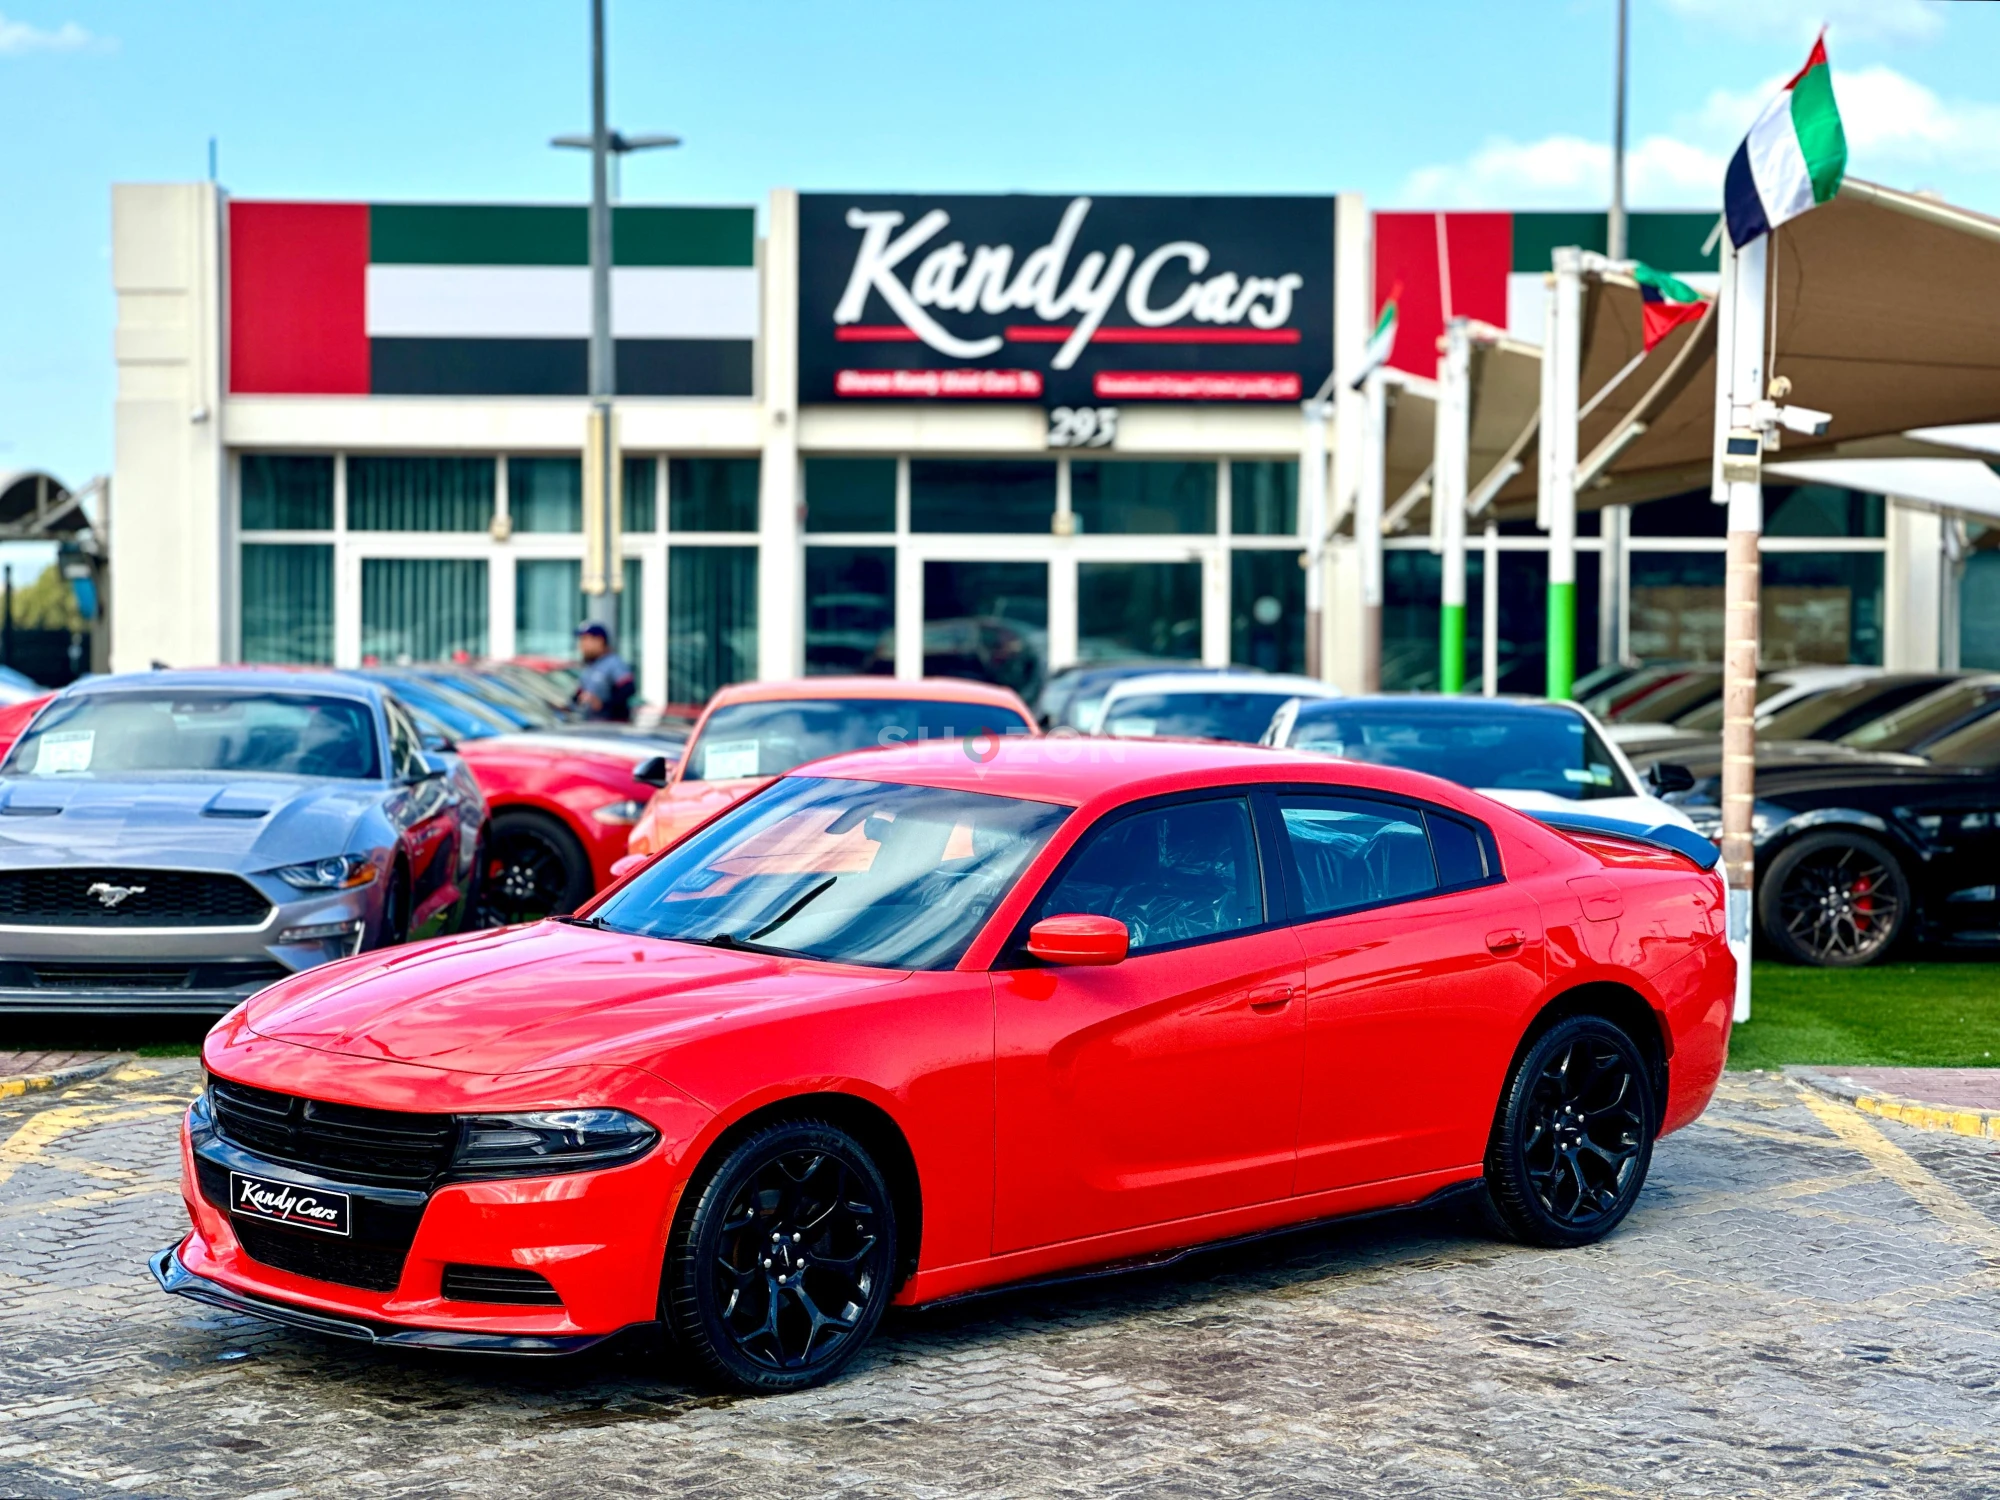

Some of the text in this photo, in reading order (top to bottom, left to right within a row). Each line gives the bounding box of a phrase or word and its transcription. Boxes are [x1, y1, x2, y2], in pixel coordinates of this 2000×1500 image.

[834, 198, 1302, 369] Kandy Cars
[1048, 406, 1119, 447] 295
[241, 1181, 337, 1219] Kandy Cars
